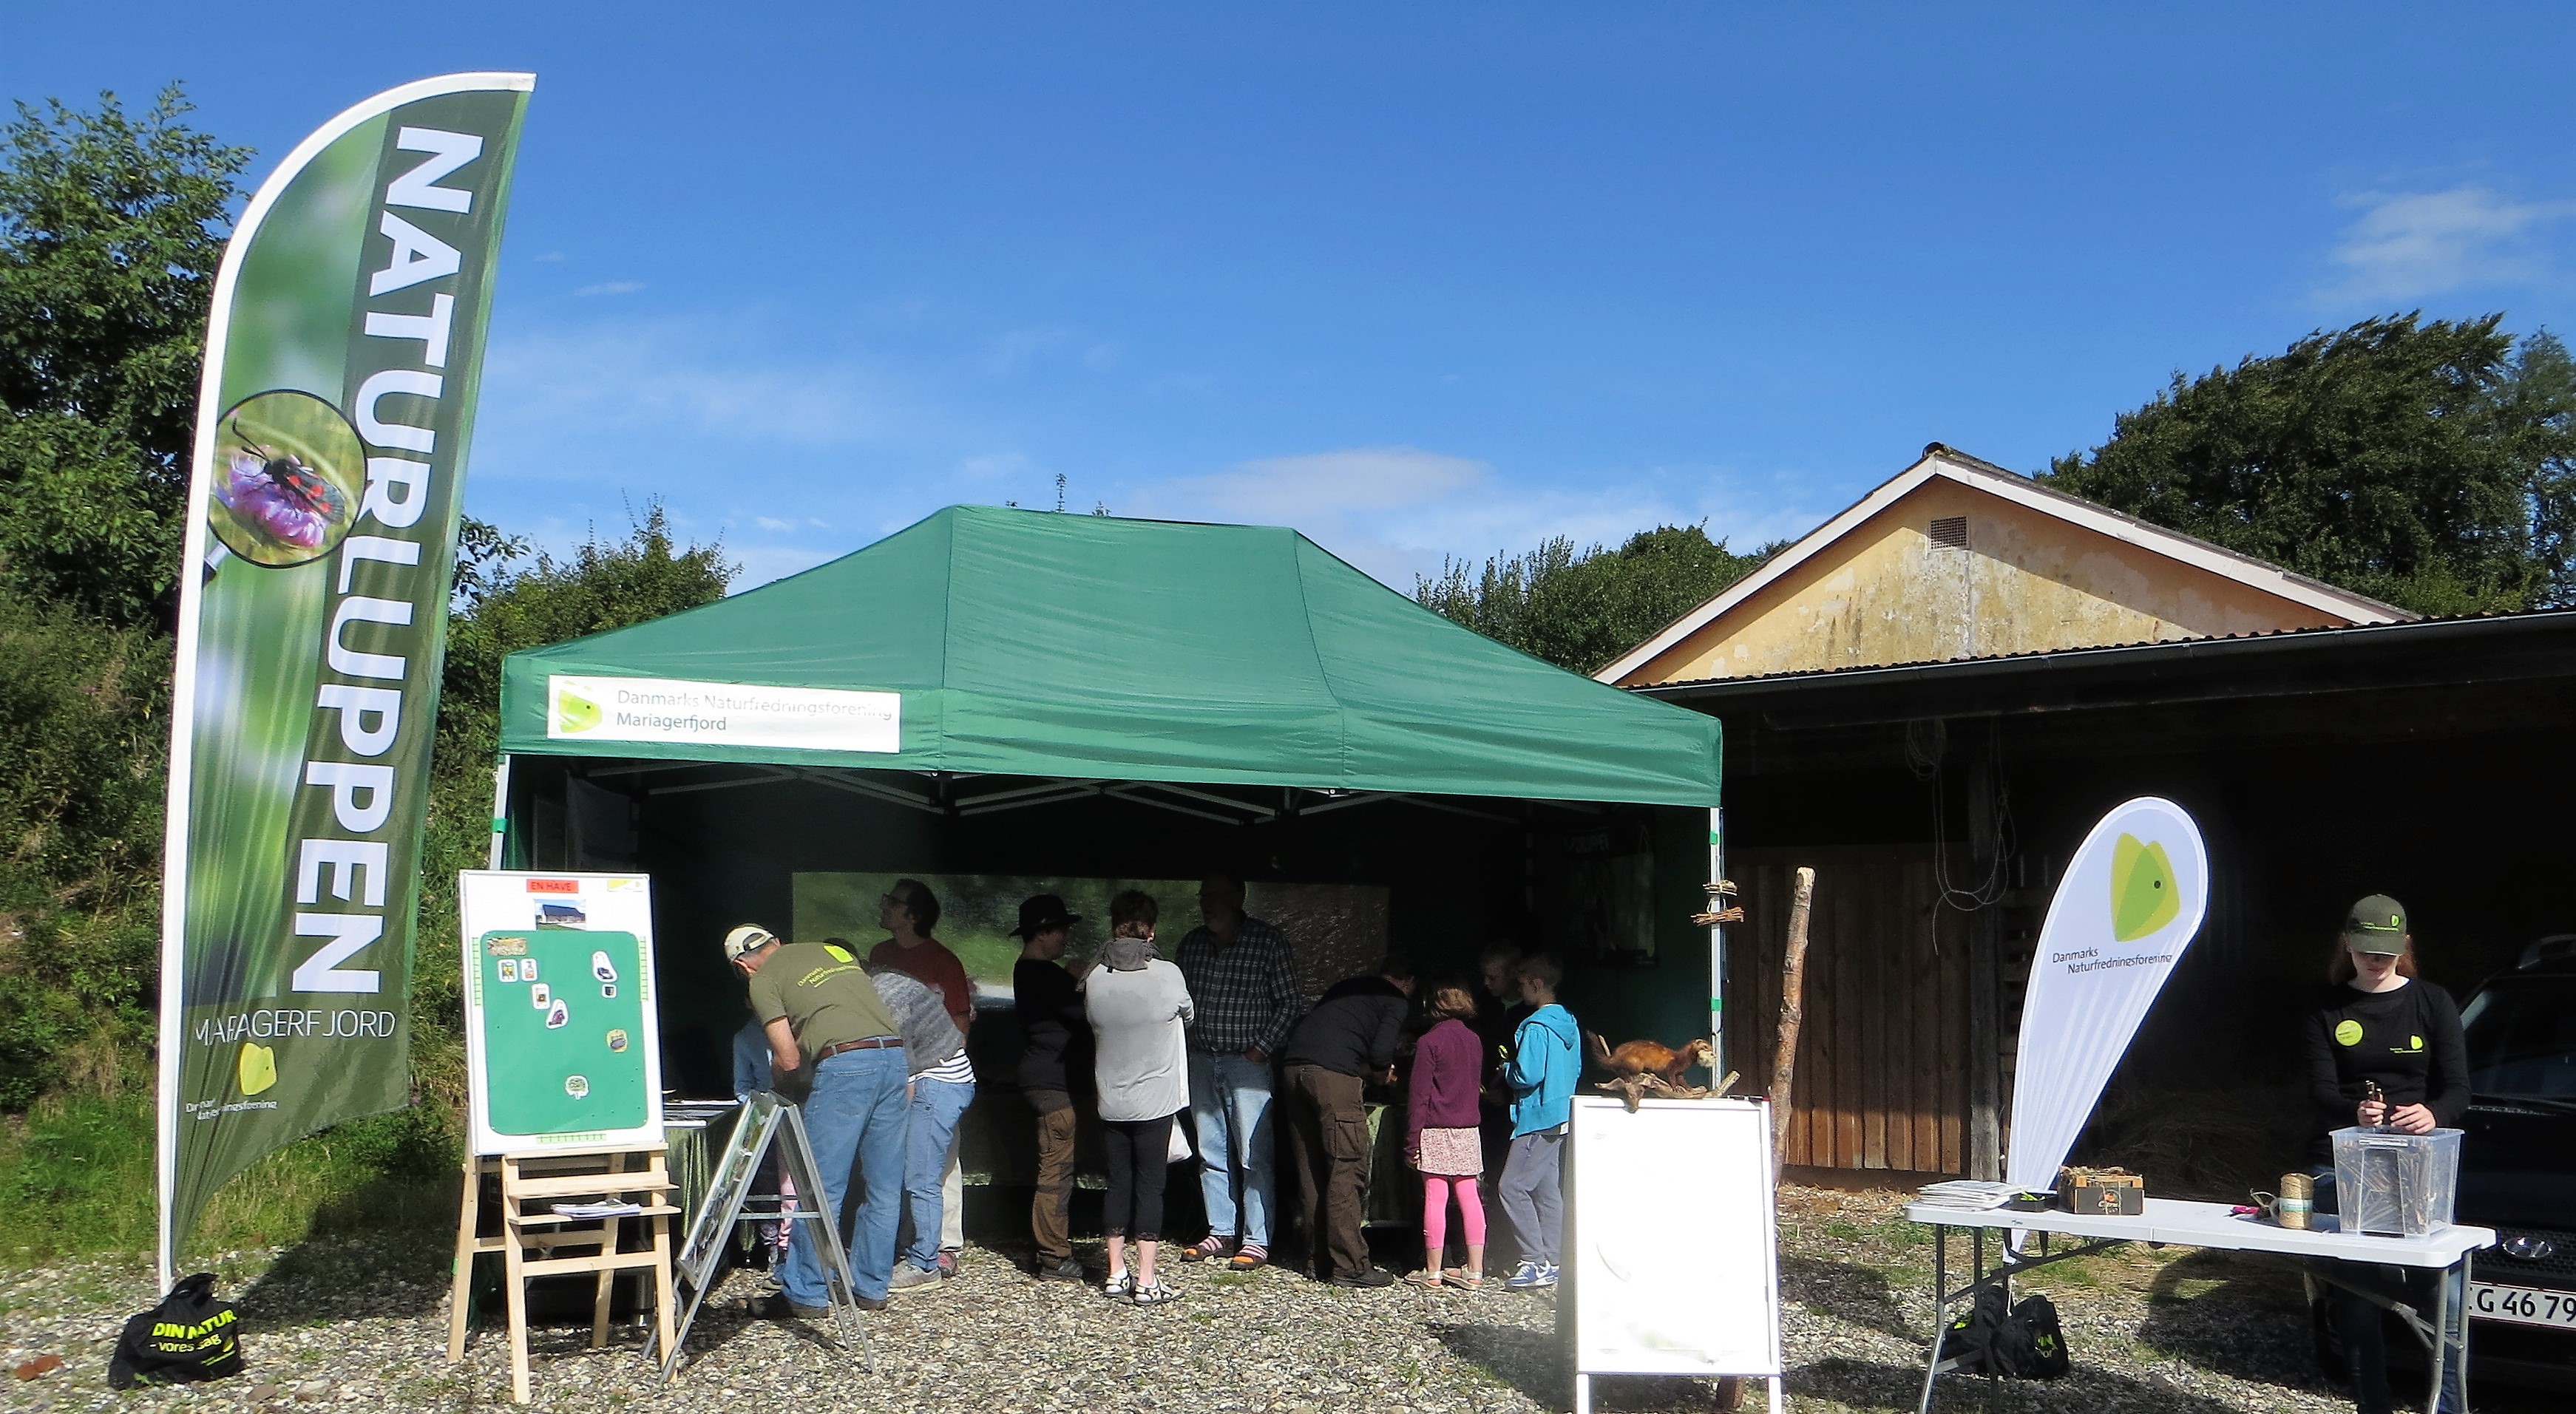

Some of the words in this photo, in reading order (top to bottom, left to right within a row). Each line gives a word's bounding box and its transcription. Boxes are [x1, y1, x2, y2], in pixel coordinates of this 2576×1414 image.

[291, 126, 484, 993] NATURLUPPEN
[618, 690, 699, 708] Danmarks
[617, 712, 728, 733] Mariagerfjord
[531, 881, 543, 890] EN
[546, 882, 572, 891] HAVE
[2053, 947, 2098, 963] Danmarks
[2468, 1287, 2495, 1313] G
[2501, 1291, 2536, 1317] 46
[152, 1322, 186, 1339] DIN
[158, 1342, 194, 1353] vores
